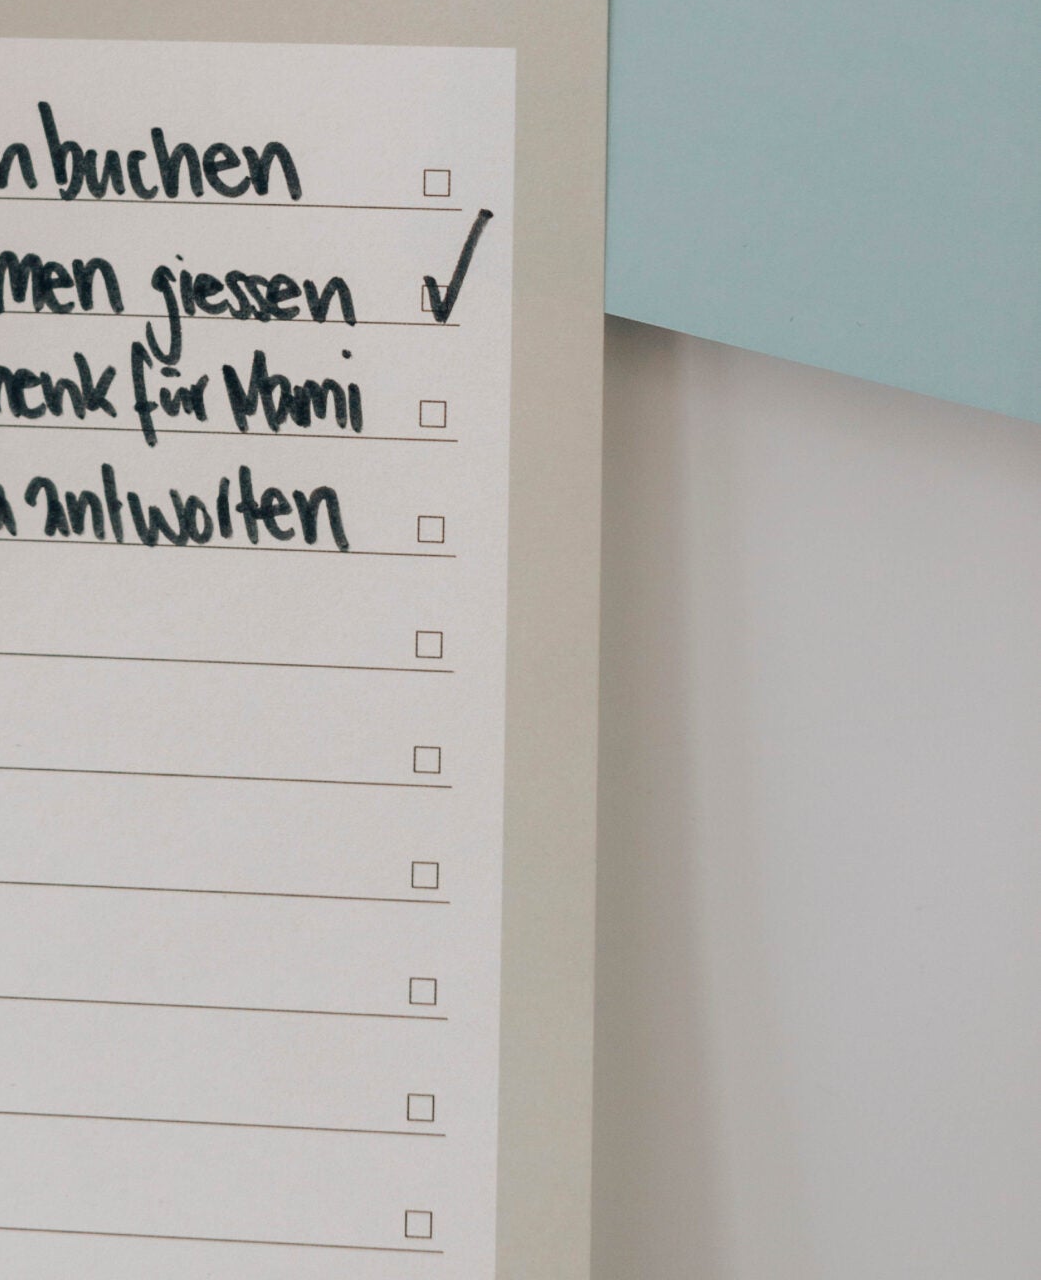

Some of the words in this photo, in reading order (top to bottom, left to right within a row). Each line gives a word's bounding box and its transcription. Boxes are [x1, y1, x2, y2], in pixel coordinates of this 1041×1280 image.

[38, 100, 302, 201] buchen
[146, 254, 357, 365] giessen
[131, 341, 209, 447] für
[222, 349, 363, 433] Mami
[24, 463, 350, 552] antworten
